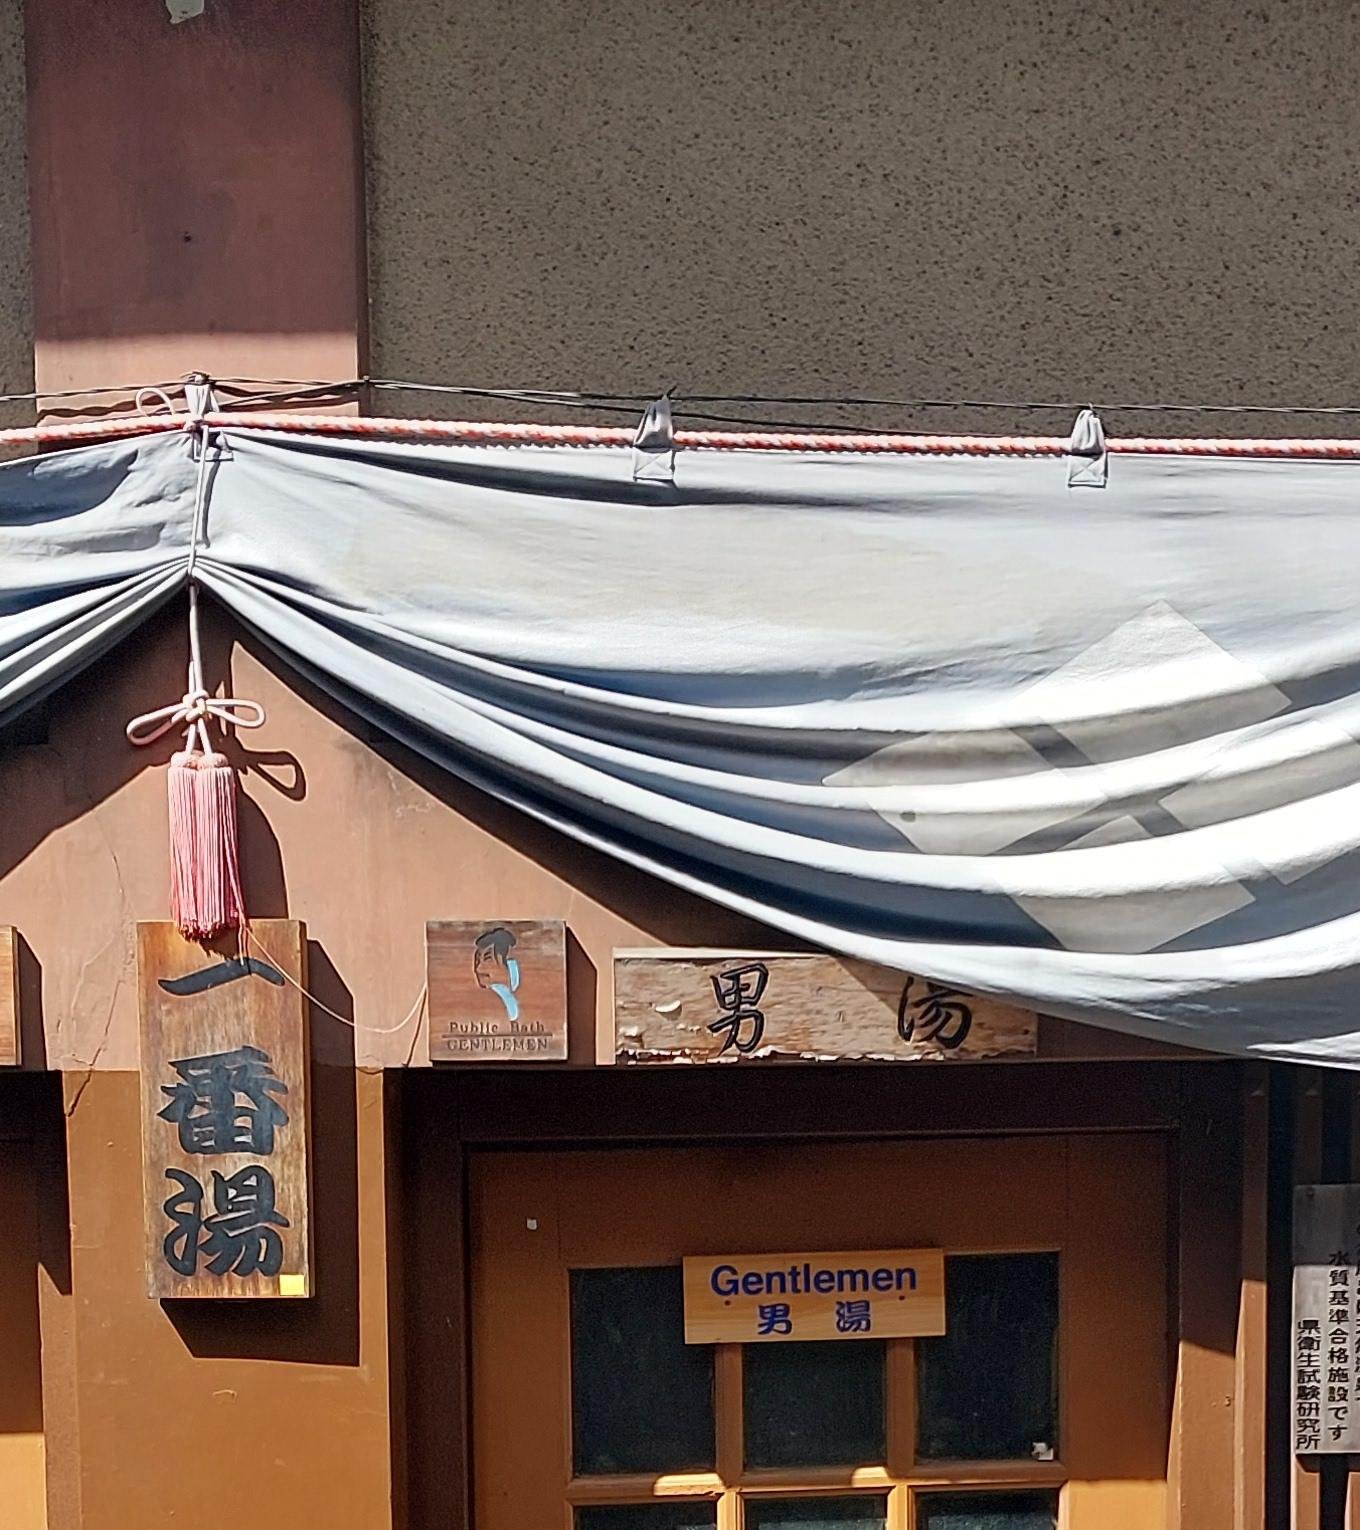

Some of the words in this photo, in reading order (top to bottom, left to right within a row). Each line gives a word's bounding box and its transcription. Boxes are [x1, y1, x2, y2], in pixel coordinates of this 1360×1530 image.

[447, 1038, 548, 1051] GENTLEMEN
[449, 1021, 499, 1034] Public
[509, 1021, 545, 1034] Bath
[155, 955, 291, 1278] 一番湯
[710, 1262, 917, 1297] Gentlemen
[757, 1299, 872, 1336] 男湯
[1327, 1250, 1350, 1441] 水質基準合格施設です
